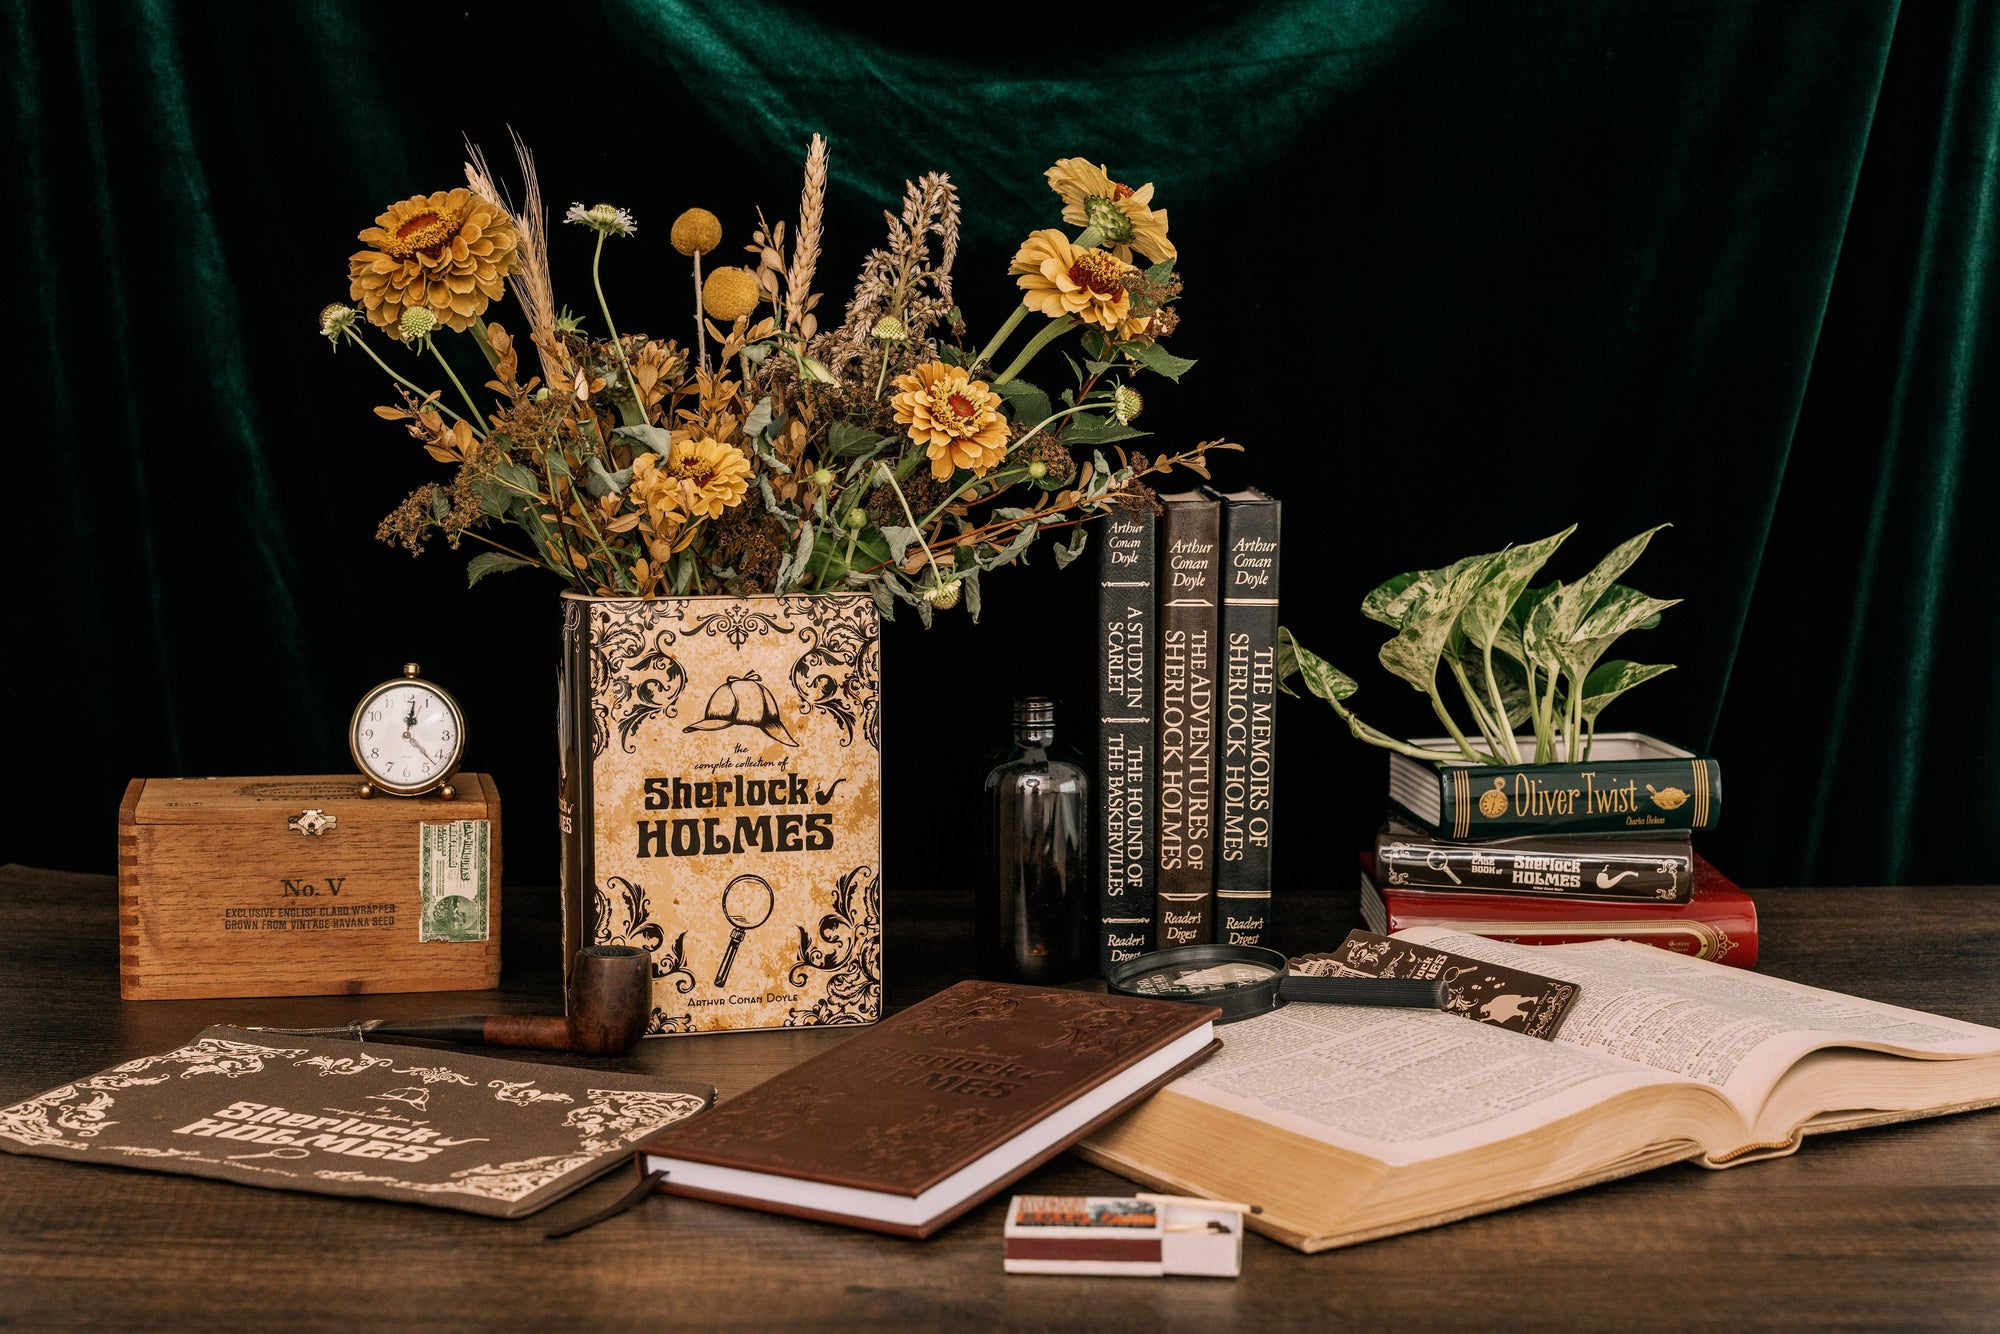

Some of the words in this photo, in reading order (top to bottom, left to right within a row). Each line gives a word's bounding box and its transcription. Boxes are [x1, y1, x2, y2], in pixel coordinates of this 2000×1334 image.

[1108, 521, 1144, 534] Arthur
[1109, 536, 1142, 549] Conan
[1169, 539, 1214, 554] Arthur
[1231, 537, 1278, 553] Arthur
[1111, 551, 1139, 568] Doyle
[1170, 555, 1209, 570] Conan
[1233, 553, 1273, 568] Conan
[1172, 571, 1206, 591] Doyle
[1235, 570, 1269, 590] Doyle
[1127, 606, 1144, 619] A
[1108, 621, 1124, 695] SCARLET
[1127, 622, 1144, 683] STUDY
[1190, 630, 1208, 670] THE
[1252, 646, 1274, 695] THE
[424, 699, 429, 708] 1
[1127, 687, 1143, 709] IN
[1163, 630, 1186, 765] SHERLOCK
[1226, 632, 1250, 757] SHERLOCK
[370, 711, 382, 722] 10
[365, 729, 374, 741] 9
[441, 730, 450, 742] 3
[370, 748, 379, 759] 8
[435, 749, 444, 760] 4
[734, 743, 750, 754] the
[1108, 734, 1124, 772] THE
[1188, 672, 1211, 840] ADVENTURES
[1250, 701, 1272, 811] MEMOIRS
[386, 761, 395, 773] 7
[402, 767, 411, 778] 6
[422, 763, 430, 773] 5
[694, 757, 734, 774] complete
[735, 756, 774, 768] collection
[778, 756, 789, 773] of
[1127, 745, 1143, 783] THE
[643, 773, 809, 811] Sherlock
[1515, 773, 1581, 817] Oliver
[1581, 772, 1638, 815] Twist
[1161, 769, 1183, 870] HOLMES
[1223, 765, 1246, 862] HOLMES
[1127, 787, 1143, 860] HOUND
[1248, 816, 1269, 848] OF
[636, 813, 834, 858] HOLMES
[1108, 776, 1124, 897] BASKERVILLES
[1187, 844, 1204, 871] OF
[1513, 855, 1581, 873] Sherlock
[1127, 863, 1143, 887] OF
[1472, 865, 1495, 874] BOOK
[1512, 870, 1581, 888] HOLMES
[281, 879, 320, 897] No.
[325, 877, 346, 896] V
[225, 908, 275, 918] EXCLUSIVE
[278, 907, 316, 918] ENGLISH
[319, 906, 349, 917] CLARO
[351, 904, 396, 915] WRAPPER
[225, 919, 258, 930] GROWN
[261, 919, 287, 930] FROM
[291, 919, 330, 929] VINTAGE
[333, 917, 369, 929] HAVANA
[372, 916, 395, 926] SEED
[1166, 927, 1198, 944] Digest
[1228, 932, 1260, 945] Digest
[213, 1101, 444, 1144] Sherlock
[172, 1118, 444, 1163] HOLMES
